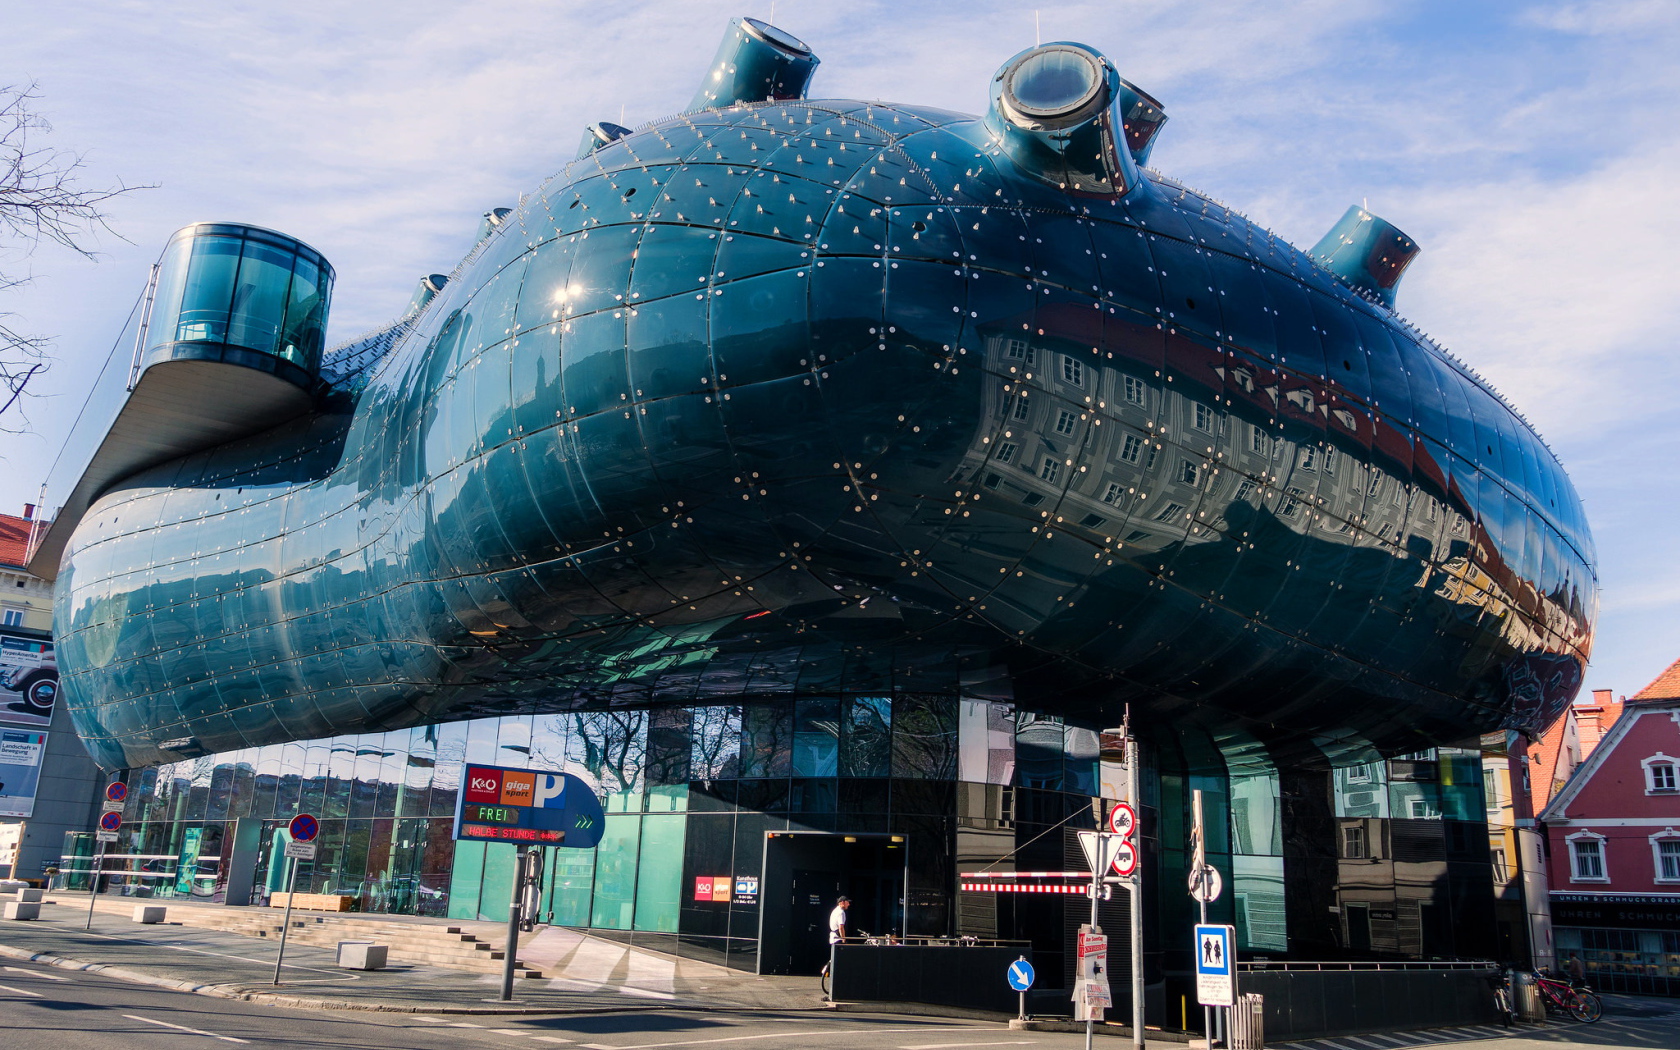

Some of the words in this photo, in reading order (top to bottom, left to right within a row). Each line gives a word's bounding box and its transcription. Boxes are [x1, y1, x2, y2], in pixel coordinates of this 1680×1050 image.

[2, 743, 31, 751] Landschaft
[505, 780, 531, 791] giga
[534, 774, 565, 808] P
[505, 790, 530, 798] sport
[479, 807, 508, 821] FREI
[469, 826, 498, 837] HALBE
[502, 828, 536, 840] STUNDE
[1560, 910, 1601, 918] UHREN
